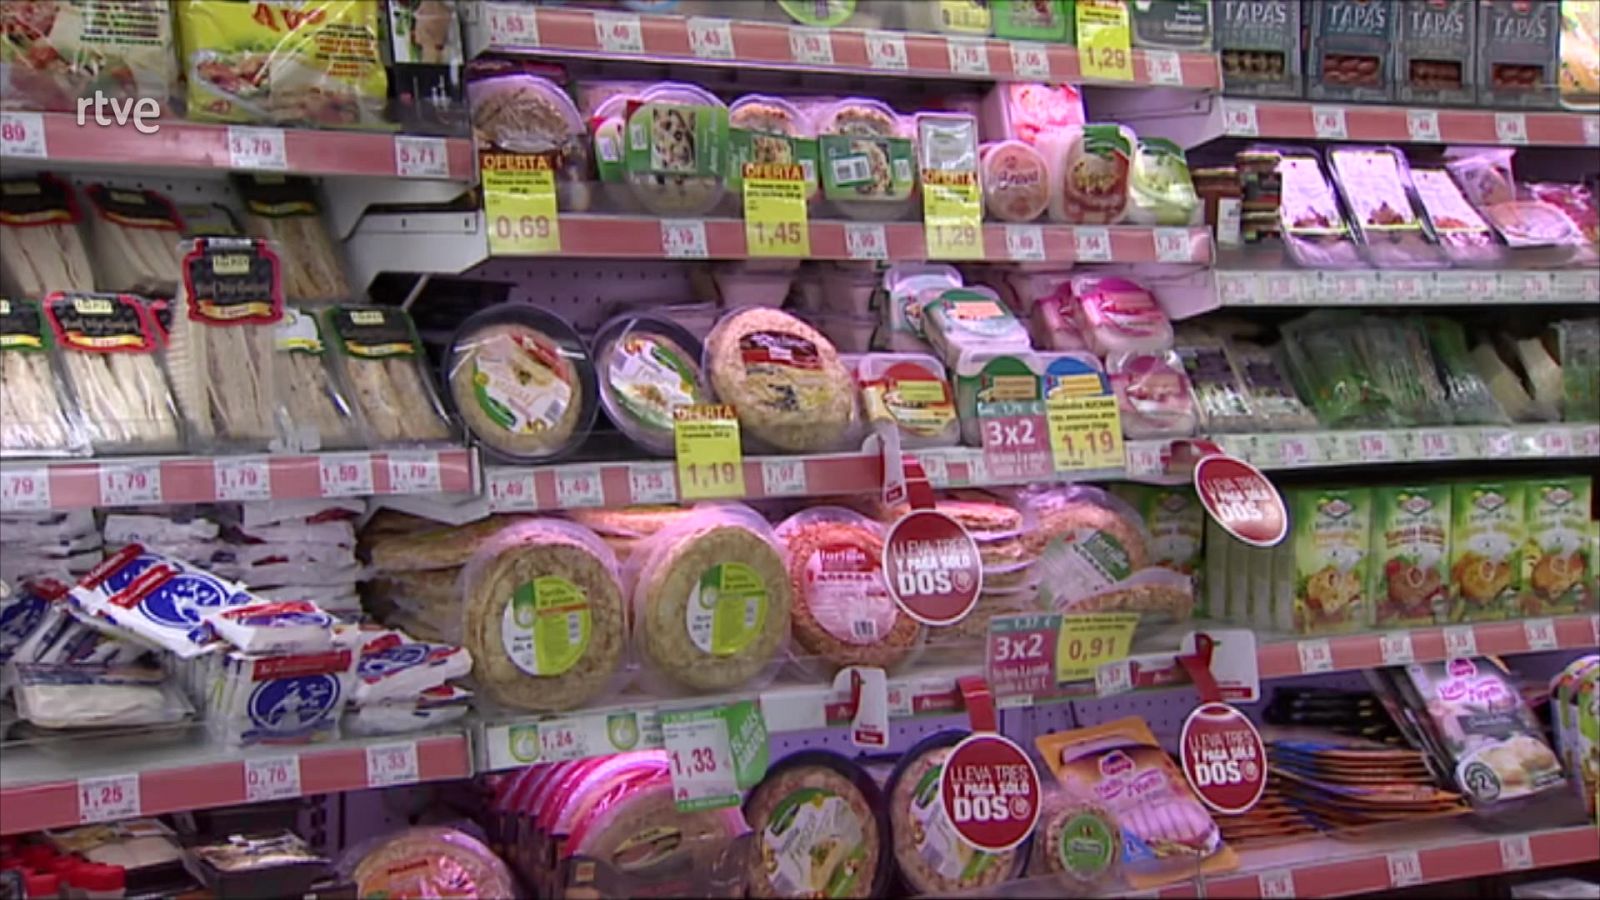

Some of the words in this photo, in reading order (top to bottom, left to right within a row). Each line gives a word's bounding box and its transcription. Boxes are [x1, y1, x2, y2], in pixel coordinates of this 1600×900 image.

[1225, 2, 1286, 23] TAPAS
[1330, 3, 1386, 28] TAPAS
[1411, 11, 1464, 33] TAPAS
[1494, 15, 1547, 38] TAPAS
[1087, 46, 1126, 71] 1,29
[233, 138, 272, 156] 3,79
[401, 148, 434, 164] 5,71
[484, 154, 549, 170] OFERTA
[744, 163, 800, 181] OFERTA
[496, 215, 549, 243] 0,69
[755, 221, 801, 247] 1,45
[935, 225, 976, 250] 1,29
[675, 404, 734, 420] OFERTA
[986, 418, 1035, 446] 3x2
[1062, 430, 1114, 459] 1,19
[107, 474, 146, 492] 1,79
[220, 469, 257, 488] 1,79
[323, 465, 358, 482] 1,59
[393, 465, 427, 480] 1,79
[688, 462, 736, 488] 1,19
[1215, 501, 1263, 522] DOS
[892, 540, 933, 557] LLEVA
[907, 555, 938, 571] PAGA
[941, 554, 971, 569] SOLO
[897, 570, 952, 596] DOS
[994, 633, 1043, 660] 3x2
[1069, 637, 1116, 662] 0,91
[1188, 733, 1226, 751] LLEVA
[673, 746, 716, 778] 1,33
[1202, 749, 1228, 763] PAGA
[1230, 745, 1256, 760] SOLO
[951, 765, 992, 783] LLEVA
[1195, 761, 1241, 786] DOS
[964, 784, 996, 797] PAGA
[999, 781, 1030, 795] SOLO
[953, 796, 1009, 822] DOS
